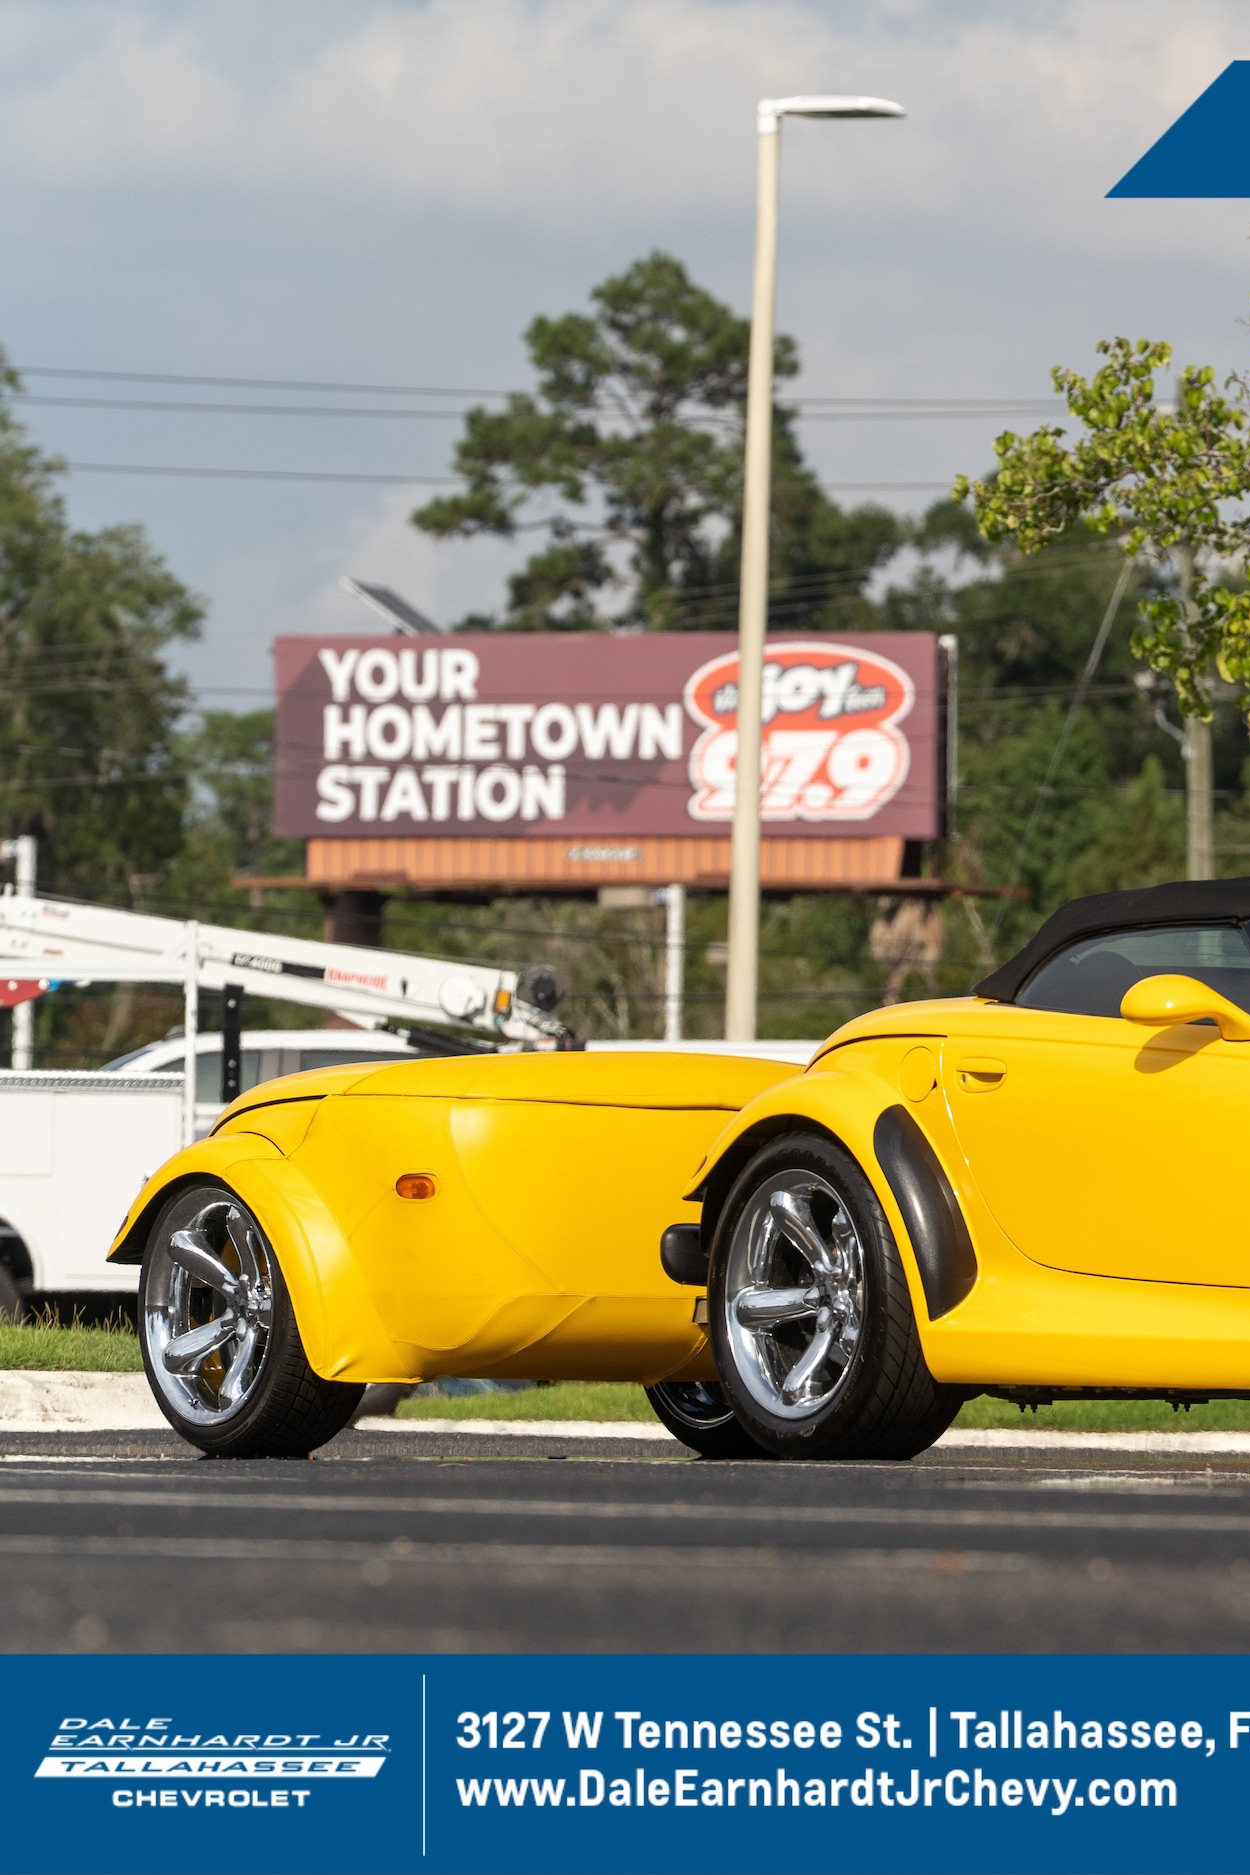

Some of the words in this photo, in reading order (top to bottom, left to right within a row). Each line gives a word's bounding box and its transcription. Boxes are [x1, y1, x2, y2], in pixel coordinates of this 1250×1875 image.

[319, 647, 480, 702] YOUR
[323, 703, 683, 761] HOMETOWN
[316, 763, 565, 821] STATION
[701, 728, 898, 811] 97.9
